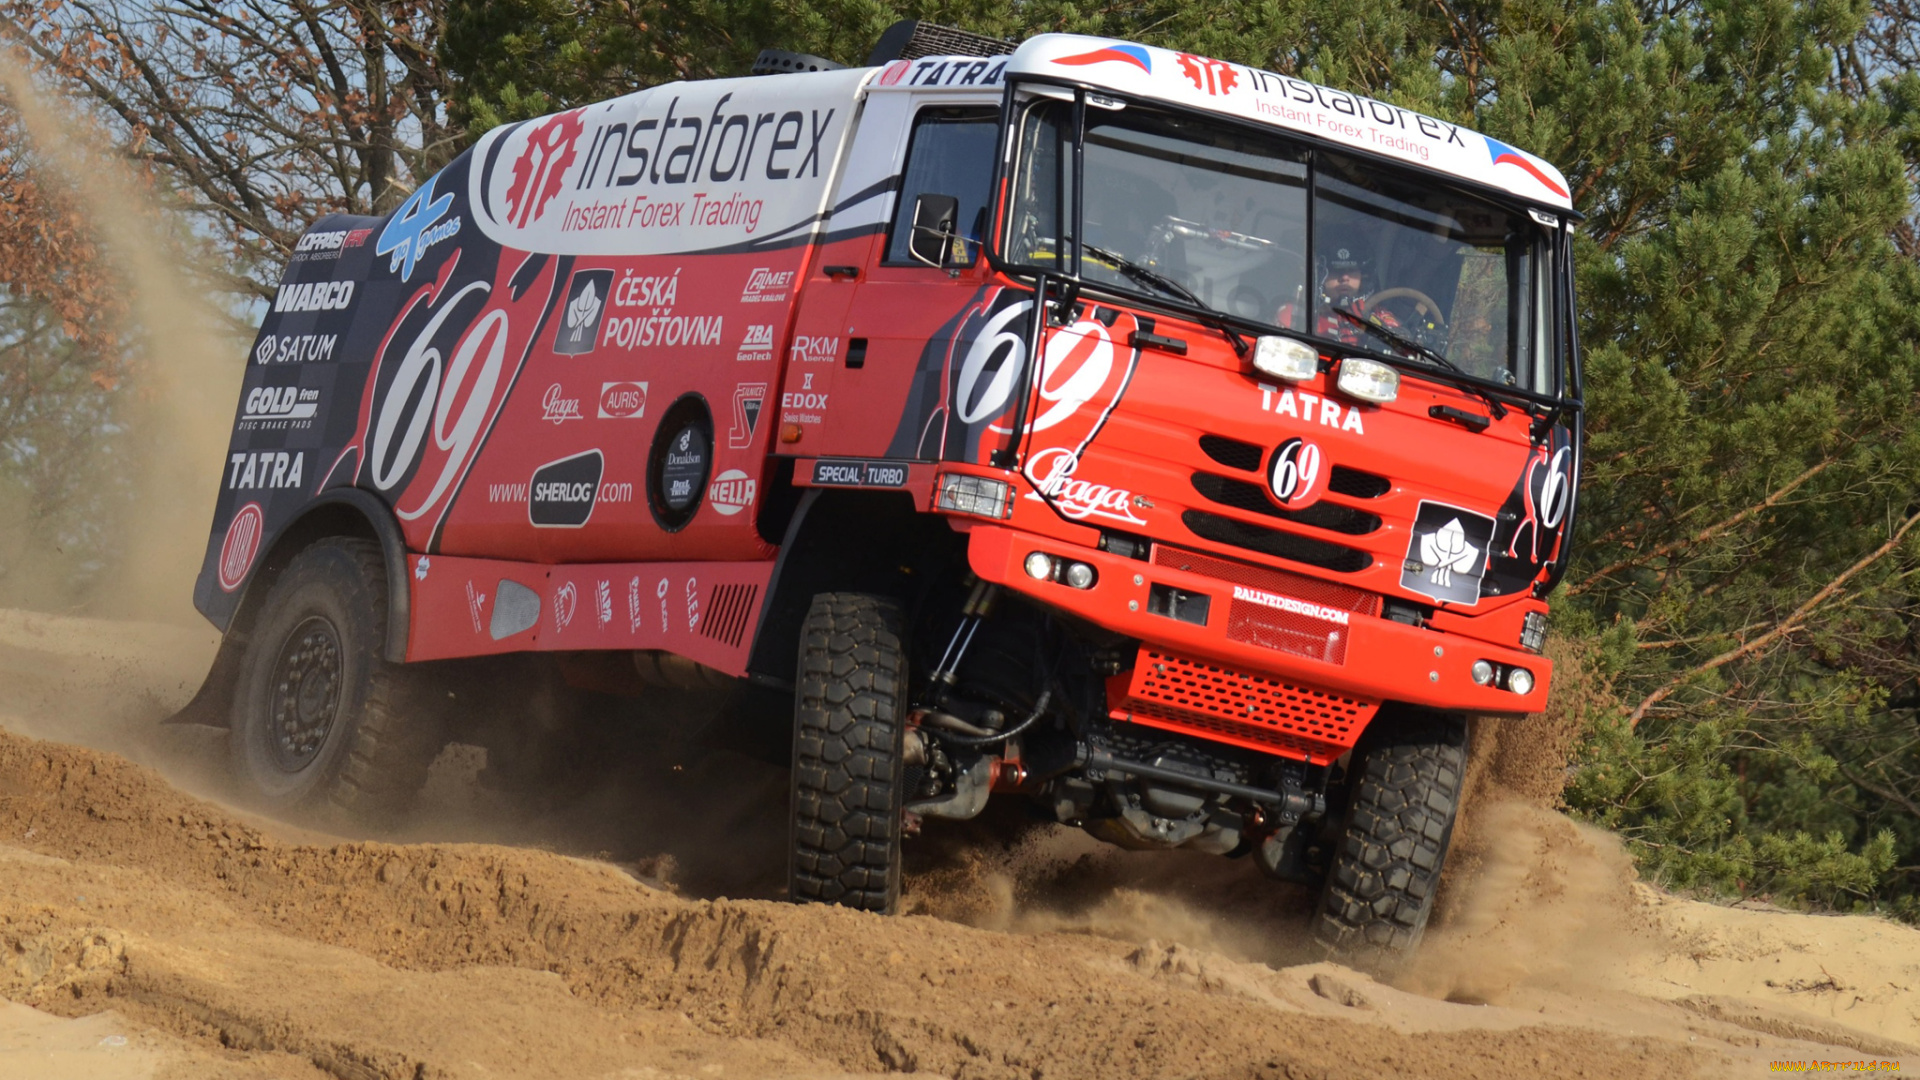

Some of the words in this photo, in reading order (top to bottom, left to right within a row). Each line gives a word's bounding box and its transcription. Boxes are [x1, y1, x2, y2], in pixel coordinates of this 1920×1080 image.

[909, 61, 1008, 86] TATRA
[577, 91, 835, 191] instaforex
[1256, 98, 1312, 125] Instant
[1316, 113, 1363, 140] Forex
[1368, 127, 1429, 161] Trading
[561, 198, 626, 232] Instant
[628, 195, 683, 228] Forex
[689, 192, 763, 233] Trading
[274, 281, 354, 312] WABCO
[615, 267, 681, 307] ČESKÁ
[602, 308, 723, 351] POJIŠŤOVNA
[743, 325, 774, 343] ZBA
[276, 334, 337, 362] SATUM
[736, 352, 772, 361] GeoTech
[791, 336, 839, 362] RKM
[956, 299, 1114, 434] 69
[245, 386, 298, 414] GOLD
[299, 388, 319, 400] fren
[372, 280, 509, 521] 69
[541, 383, 584, 424] Praga
[606, 391, 639, 408] AURIS
[782, 393, 829, 409] EDOX
[1258, 383, 1364, 435] TATRA
[239, 421, 258, 430] DISC
[261, 420, 288, 430] BRAKE
[291, 420, 312, 429] PADS
[783, 412, 799, 424] Swiss
[801, 413, 822, 424] Watches
[229, 452, 304, 490] TATRA
[668, 451, 701, 465] Donaldson
[1272, 440, 1321, 501] 69
[818, 466, 860, 483] SPECIAL
[868, 467, 904, 485] TURBO
[1024, 446, 1147, 526] Praga
[709, 478, 756, 506] HELLA
[1233, 586, 1350, 625] RALLYEDESIGN.COM
